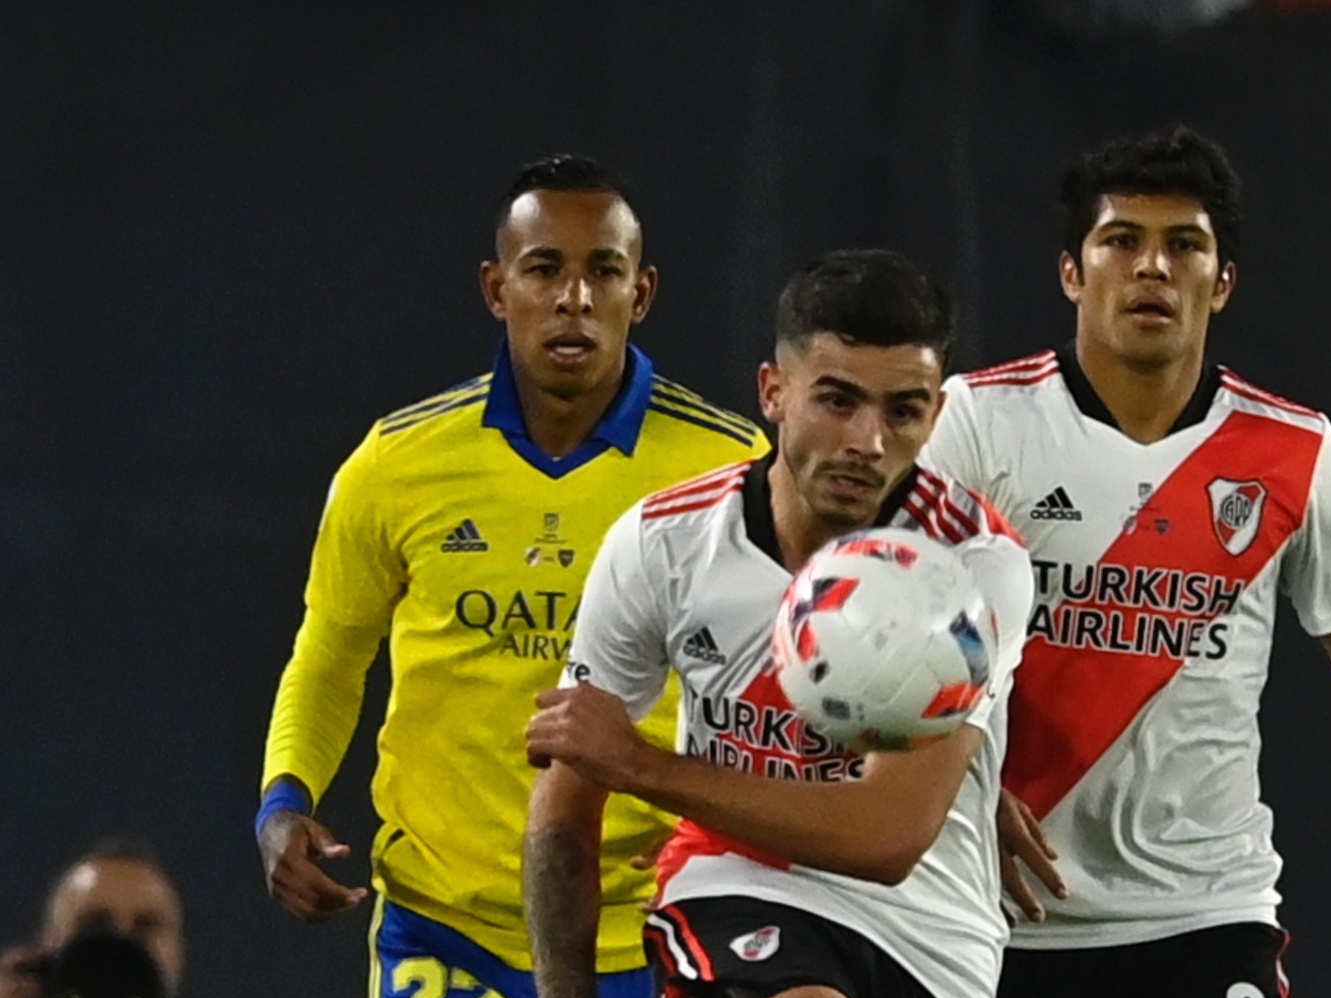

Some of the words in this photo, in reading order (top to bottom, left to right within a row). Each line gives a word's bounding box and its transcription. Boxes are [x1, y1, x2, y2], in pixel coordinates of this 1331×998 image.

[1030, 508, 1083, 522] adidas
[1030, 559, 1245, 617] TURKISH
[1026, 603, 1230, 661] AIRLINES
[683, 644, 727, 666] adidas
